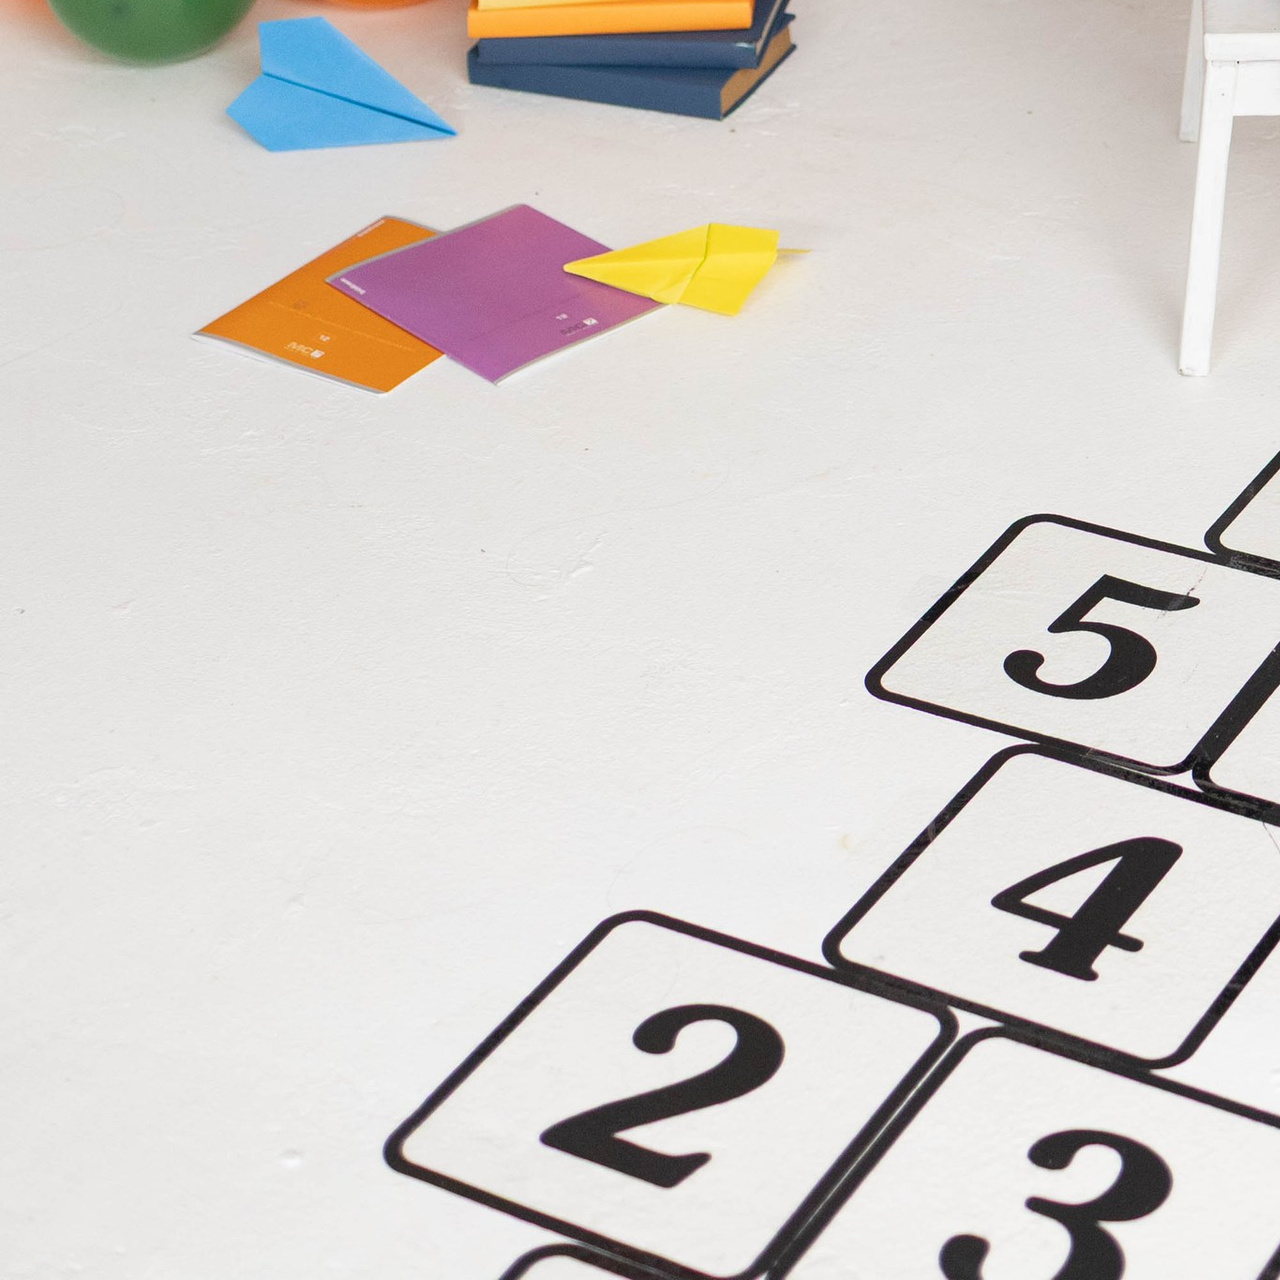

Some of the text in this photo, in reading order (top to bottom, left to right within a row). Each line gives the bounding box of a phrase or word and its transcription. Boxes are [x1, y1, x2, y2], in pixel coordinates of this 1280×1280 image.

[1003, 574, 1201, 700] 5
[990, 836, 1184, 983] 4
[539, 1004, 785, 1189] 2
[938, 1129, 1174, 1280] 3
